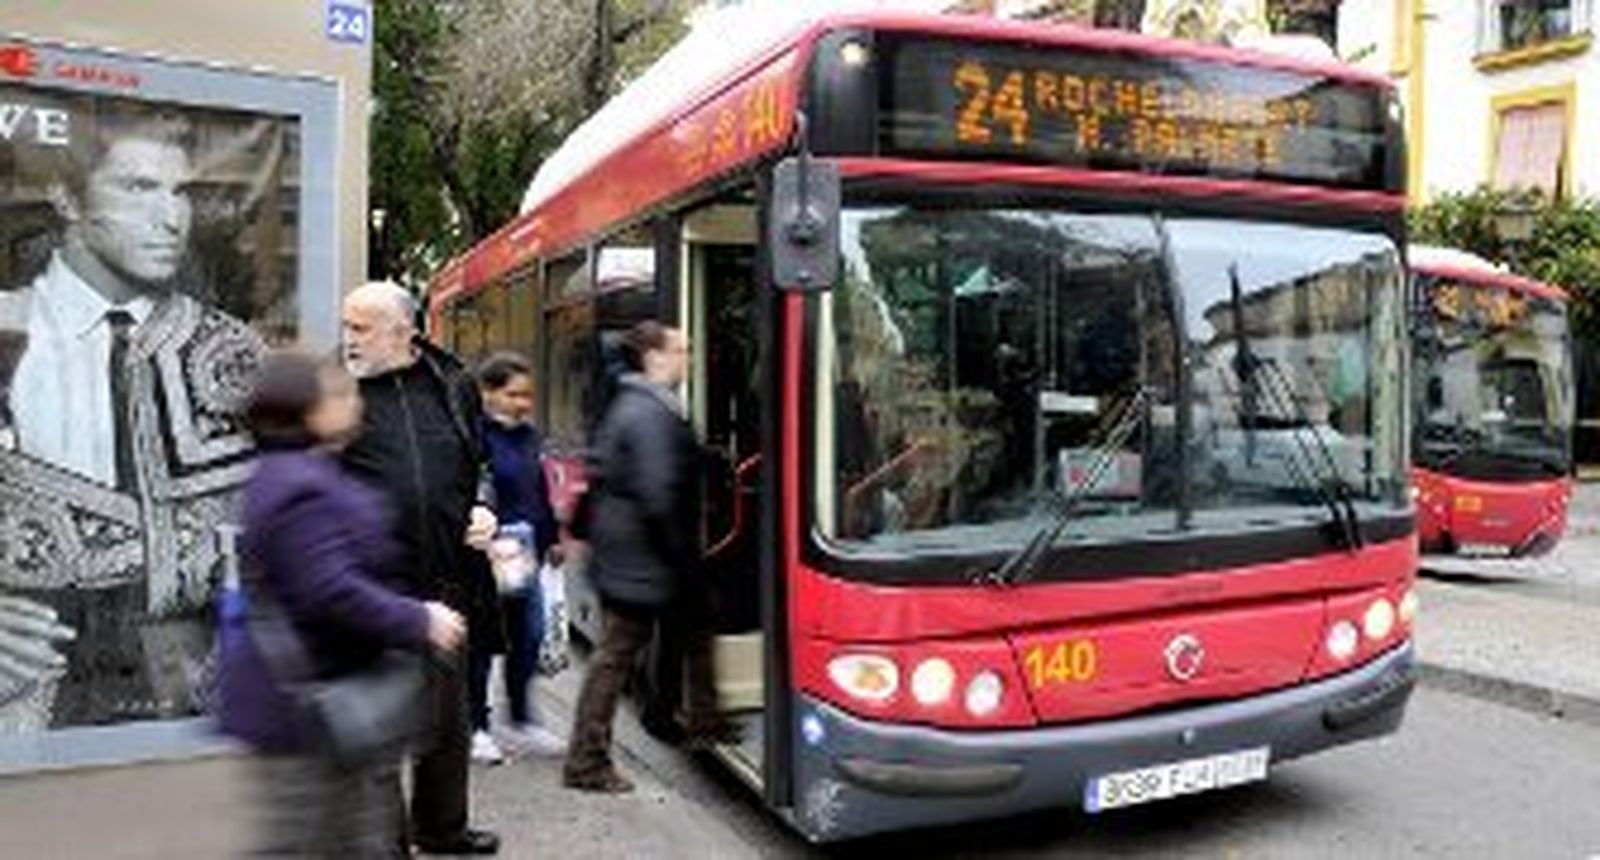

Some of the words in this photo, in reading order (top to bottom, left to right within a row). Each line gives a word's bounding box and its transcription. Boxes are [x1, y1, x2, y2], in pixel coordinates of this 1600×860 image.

[328, 9, 364, 39] 24
[953, 61, 1030, 146] 24
[1025, 639, 1096, 689] 140
